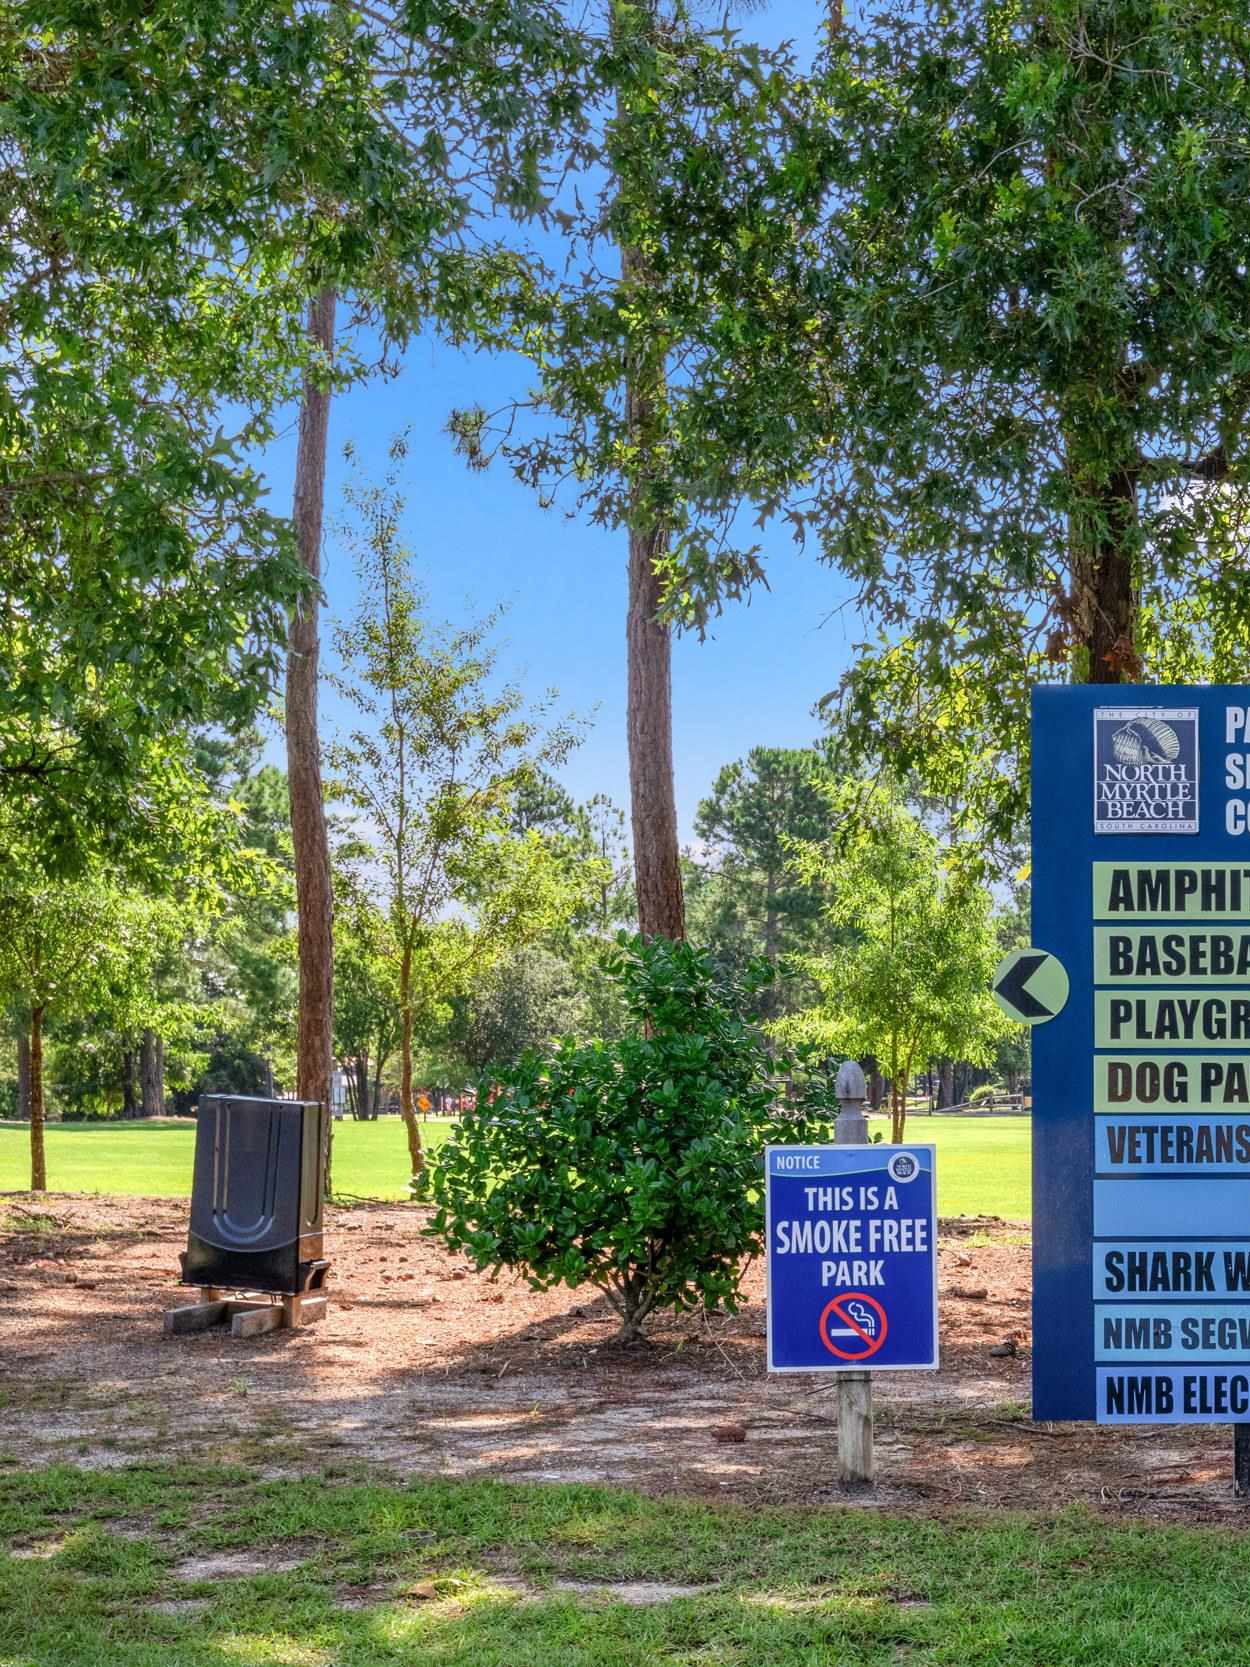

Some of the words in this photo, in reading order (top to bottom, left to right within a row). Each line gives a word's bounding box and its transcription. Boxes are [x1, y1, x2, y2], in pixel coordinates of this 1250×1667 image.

[1104, 764, 1186, 781] NORTH
[1101, 783, 1191, 800] MYRTLE
[1107, 802, 1185, 818] BEACH
[1107, 1062, 1188, 1104] DOG
[777, 1156, 820, 1169] NOTICE
[804, 1187, 853, 1211] THIS
[860, 1187, 879, 1210] IS
[884, 1186, 898, 1210] A
[776, 1220, 862, 1254] SMOKE
[870, 1219, 928, 1252] FREE
[822, 1261, 885, 1287] PARK
[1105, 1251, 1216, 1293] SHARK
[1103, 1317, 1172, 1351] NMB
[1106, 1375, 1174, 1415] NMB
